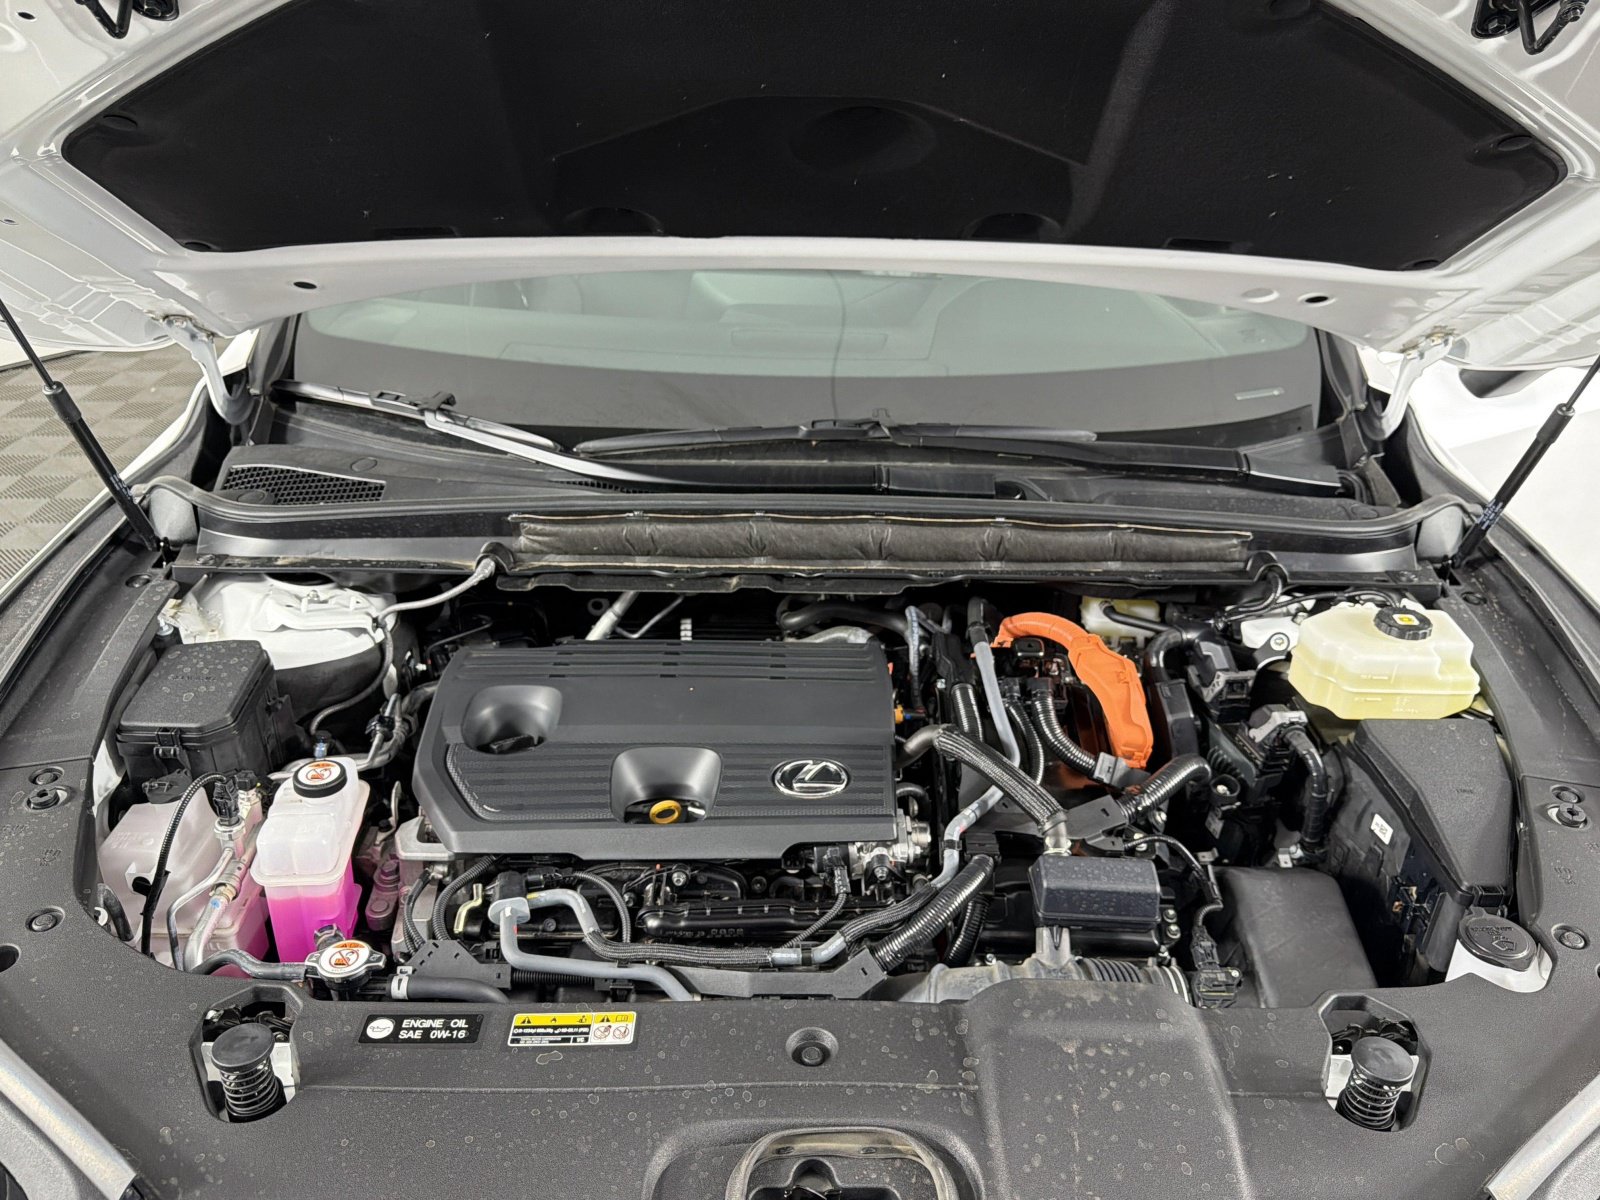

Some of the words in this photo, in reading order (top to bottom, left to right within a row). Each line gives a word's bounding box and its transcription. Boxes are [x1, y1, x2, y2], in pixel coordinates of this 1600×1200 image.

[401, 1019, 445, 1028] ENGINE
[450, 1019, 469, 1028] OIL
[398, 1029, 424, 1039] SAE
[429, 1029, 466, 1039] 0W-16
